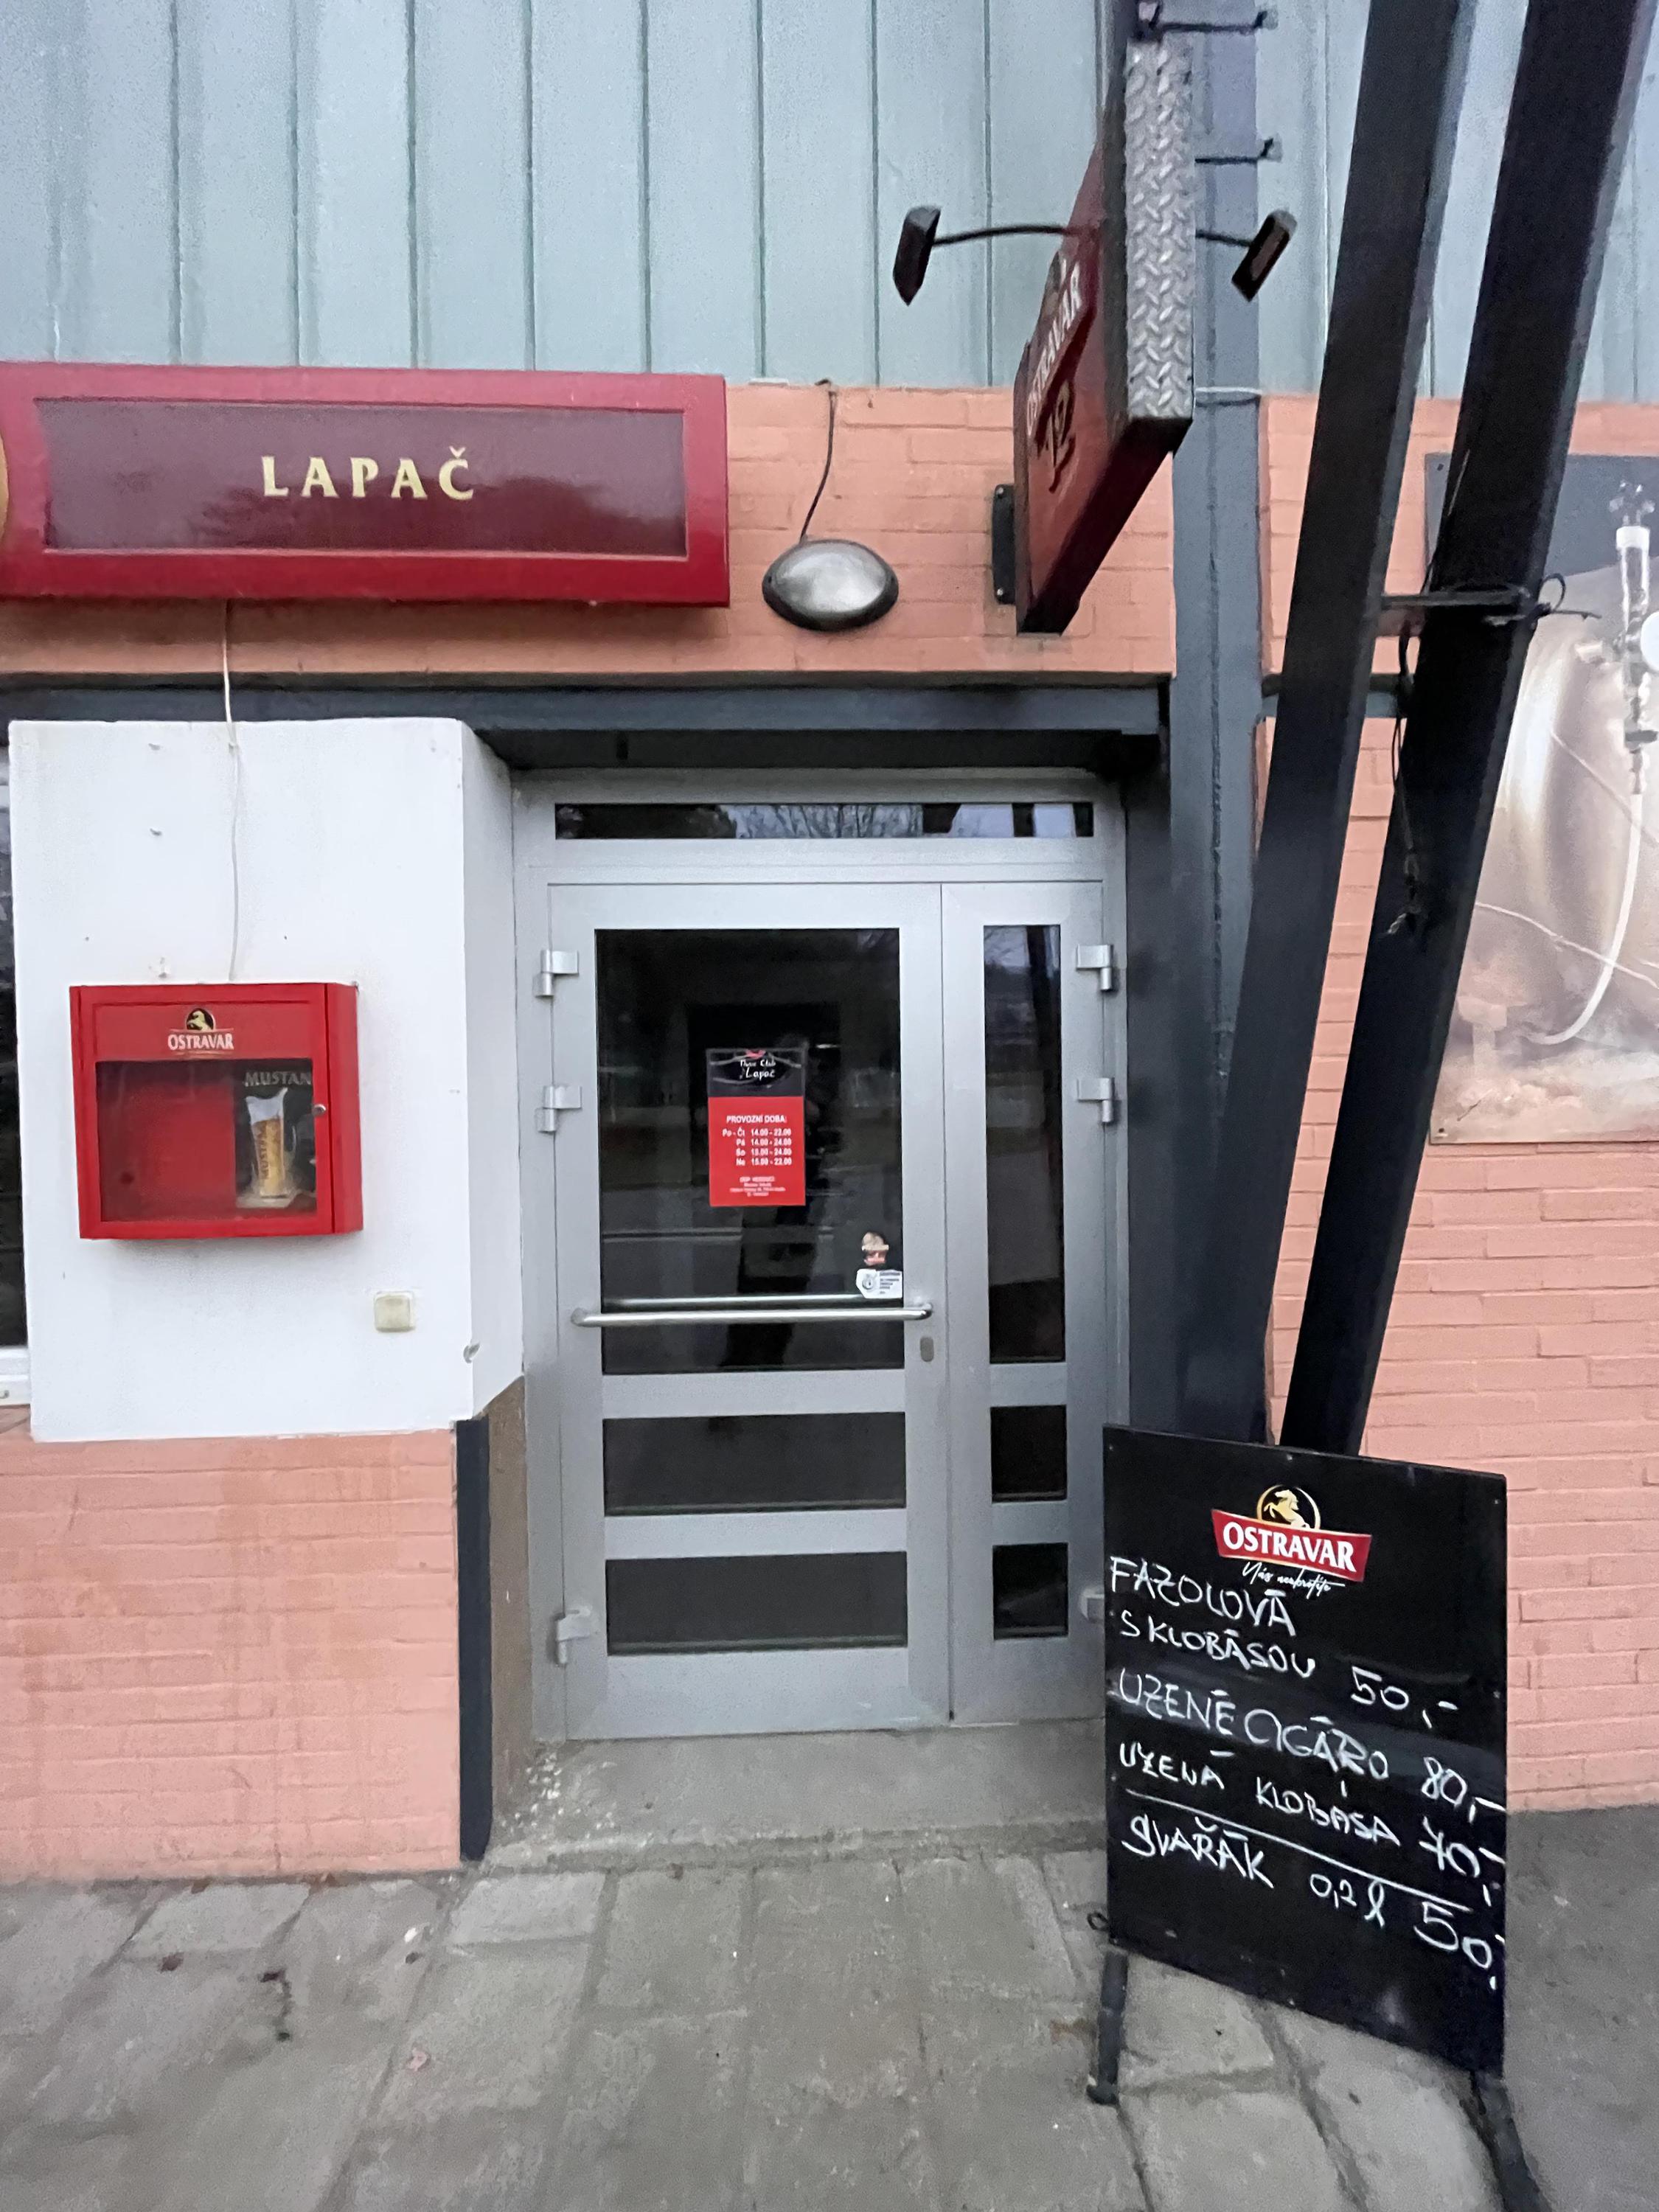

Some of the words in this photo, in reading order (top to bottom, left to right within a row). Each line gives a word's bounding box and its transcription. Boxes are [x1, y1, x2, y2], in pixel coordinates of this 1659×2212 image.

[261, 446, 476, 501] LAPAČ
[167, 1033, 234, 1051] OSTRAVAR
[760, 1057, 776, 1067] Club
[726, 1114, 763, 1124] PROVOZNÍ
[1222, 1521, 1357, 1573] OSTRAVAR
[1121, 1814, 1274, 1888] SVAŘÁK
